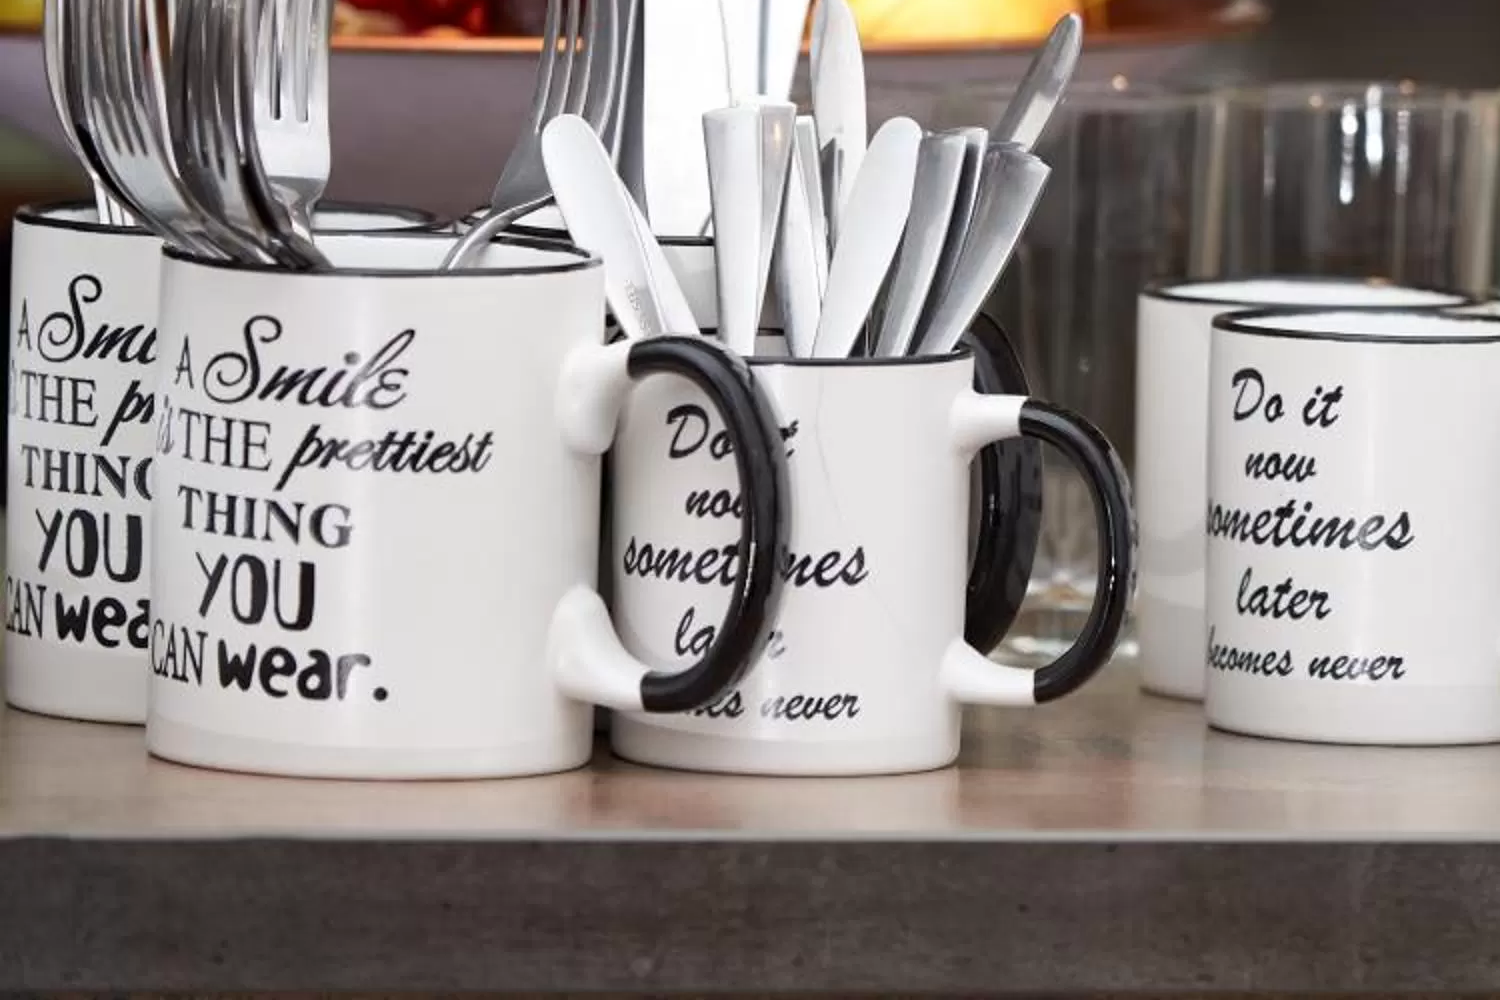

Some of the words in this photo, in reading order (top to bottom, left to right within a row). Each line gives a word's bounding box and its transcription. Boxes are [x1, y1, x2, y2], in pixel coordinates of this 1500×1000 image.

[17, 297, 32, 352] A
[175, 334, 194, 389] A
[203, 315, 416, 410] Smile
[20, 369, 99, 427] THE
[1231, 367, 1284, 423] Do
[1302, 385, 1343, 428] it
[179, 408, 272, 472] THE
[273, 424, 494, 492] prettiest
[1245, 452, 1316, 483] now
[35, 508, 143, 583] YOU
[177, 485, 353, 549] THING
[55, 591, 150, 649] wea
[195, 551, 315, 631] YOU
[1237, 566, 1331, 620] later
[151, 618, 208, 686] CAN
[218, 639, 388, 702] wear.
[1308, 654, 1406, 680] never
[761, 693, 860, 720] never
